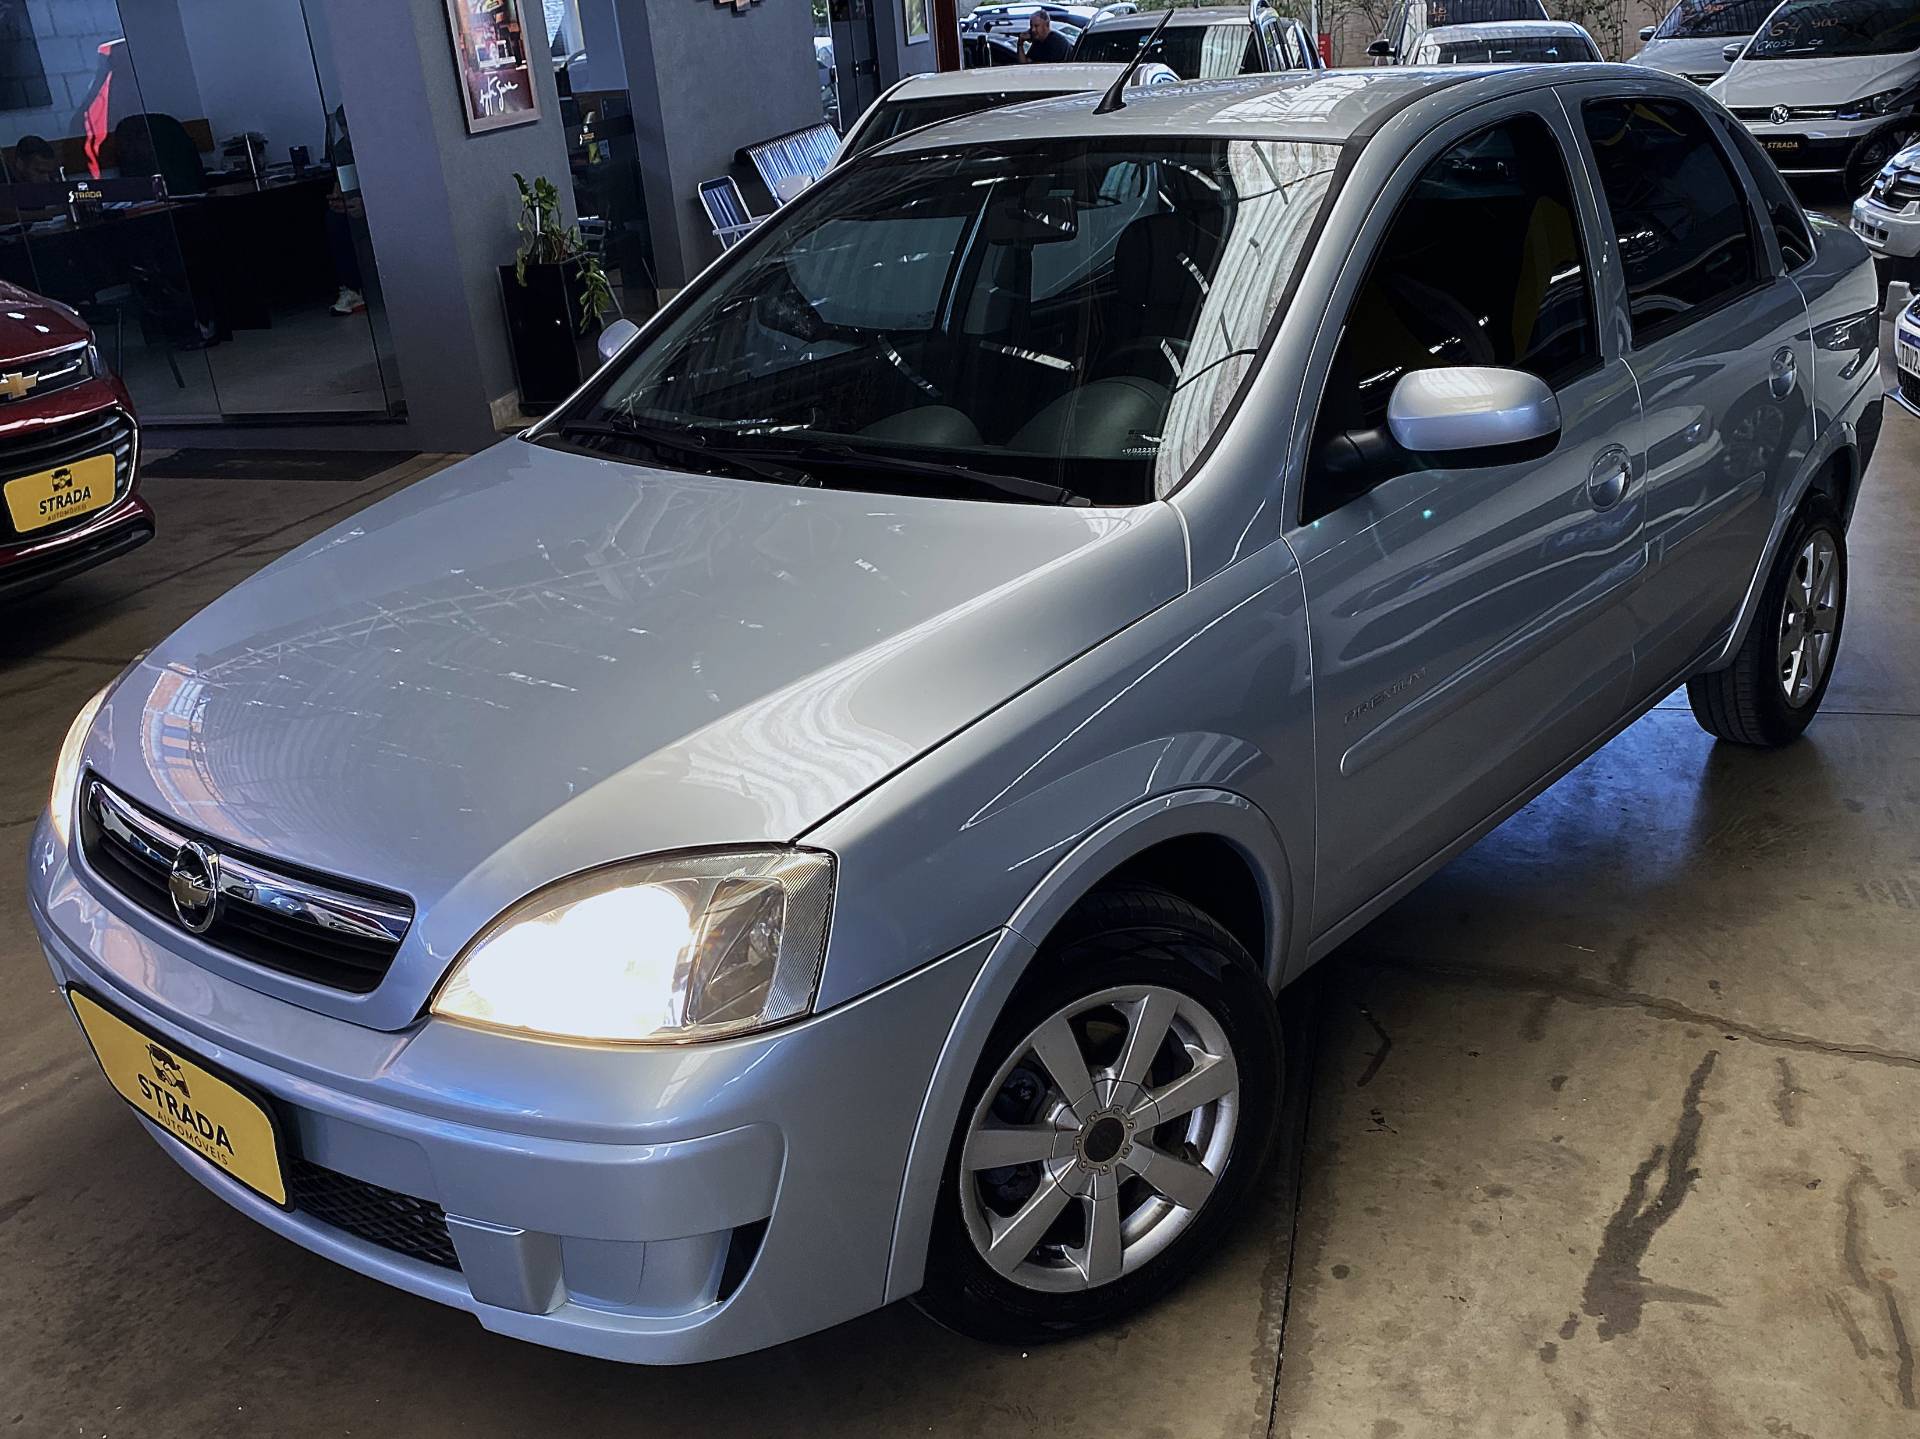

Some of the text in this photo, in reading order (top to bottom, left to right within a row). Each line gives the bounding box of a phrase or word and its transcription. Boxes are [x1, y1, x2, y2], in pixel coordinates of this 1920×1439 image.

[1767, 141, 1799, 149] STRADA
[39, 486, 92, 515] STRADA
[137, 1073, 235, 1156] STRADA
